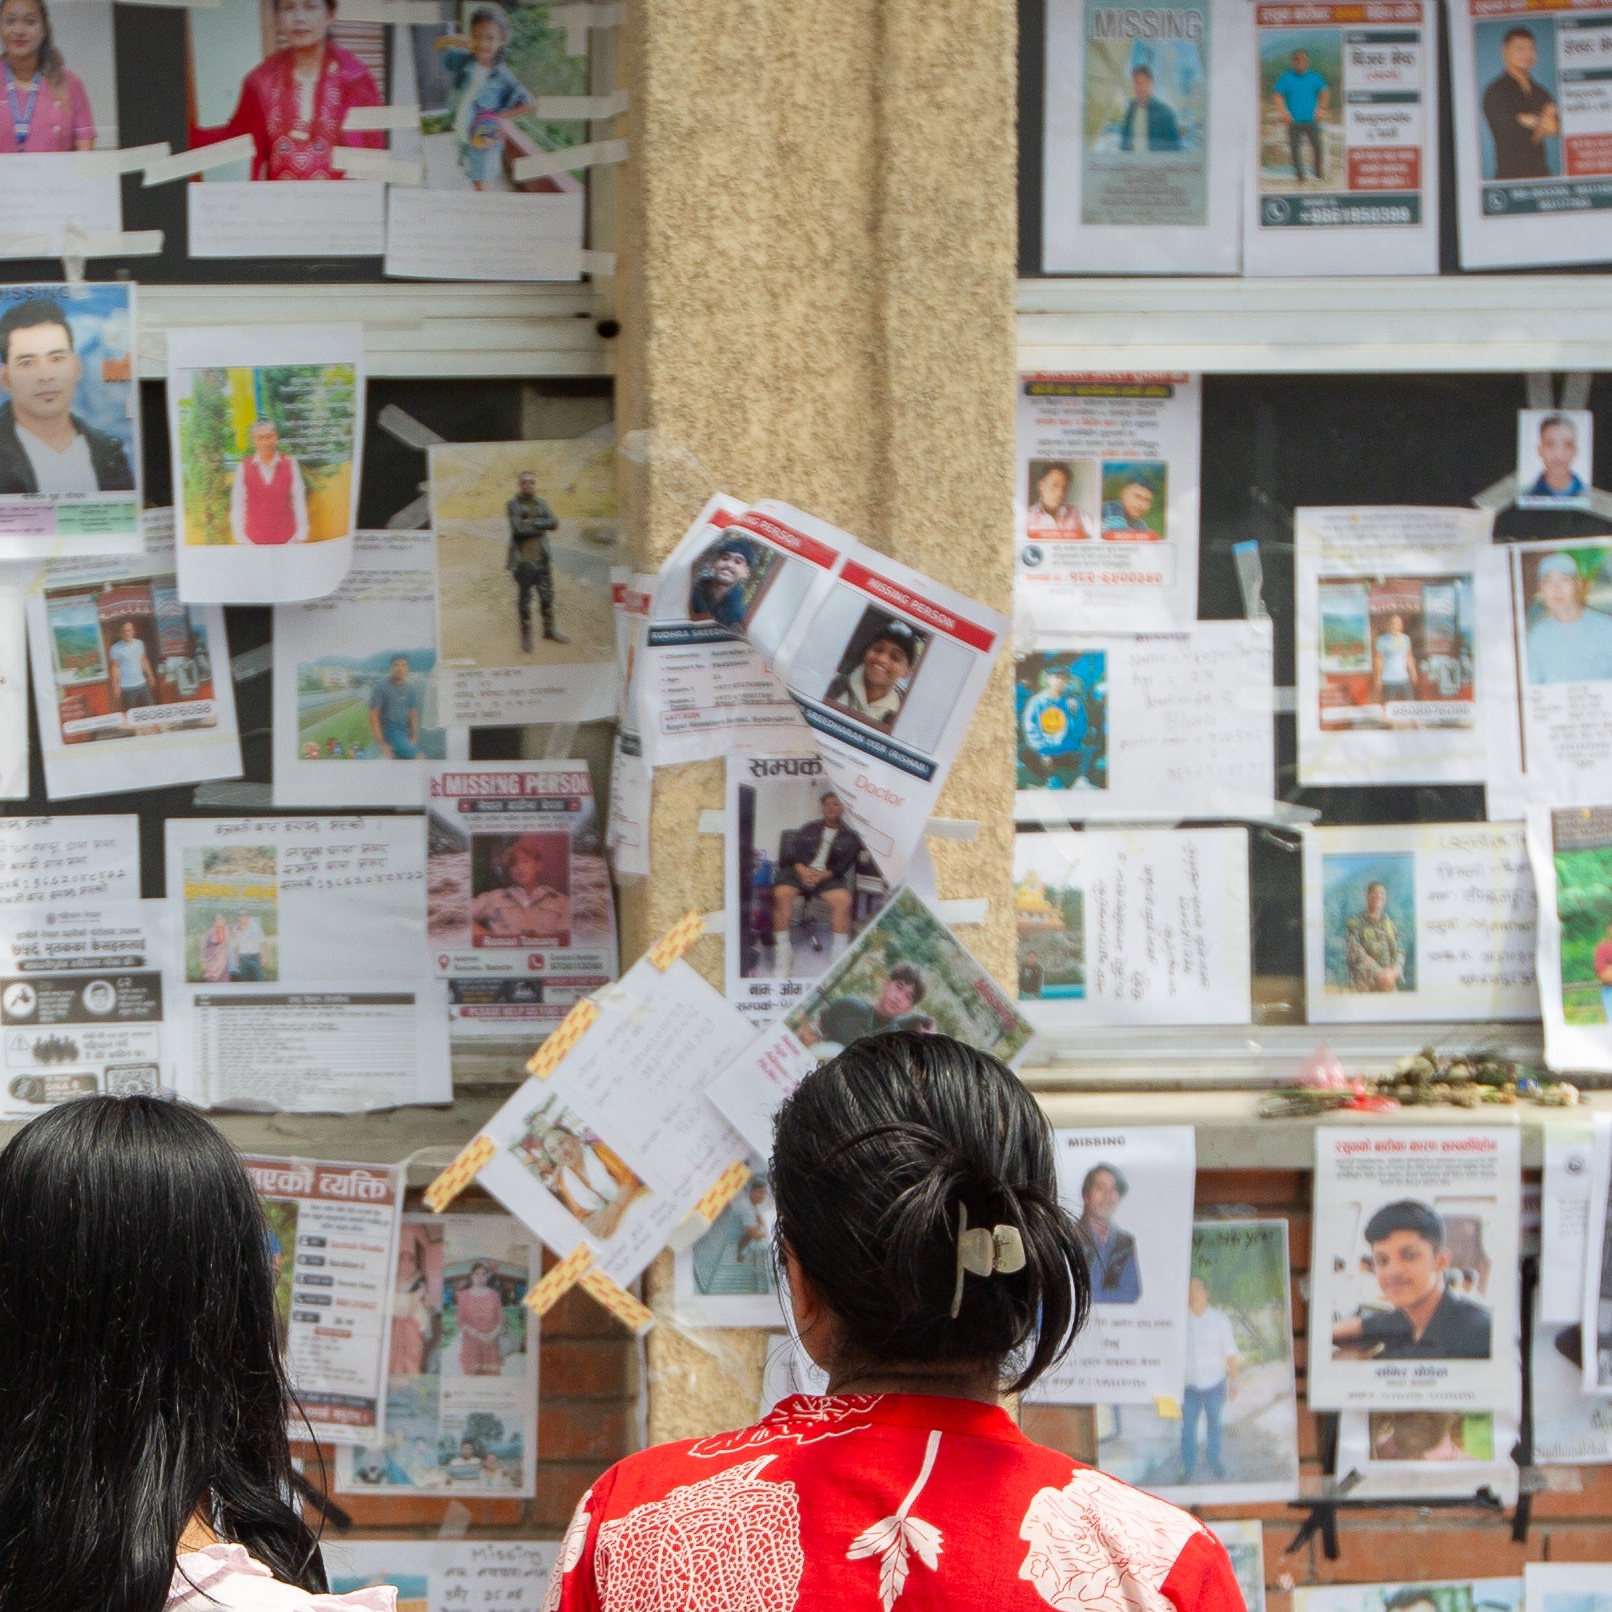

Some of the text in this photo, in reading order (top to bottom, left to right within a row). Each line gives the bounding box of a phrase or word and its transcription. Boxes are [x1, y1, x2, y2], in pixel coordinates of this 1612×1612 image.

[1092, 9, 1201, 40] MISSING
[866, 577, 956, 629] MISSING PERSON
[445, 773, 520, 795] MISSING
[853, 774, 906, 807] Doctor
[1069, 1136, 1126, 1148] MISSING
[318, 1167, 390, 1198] व्यक्ति
[473, 1545, 541, 1570] Missing
